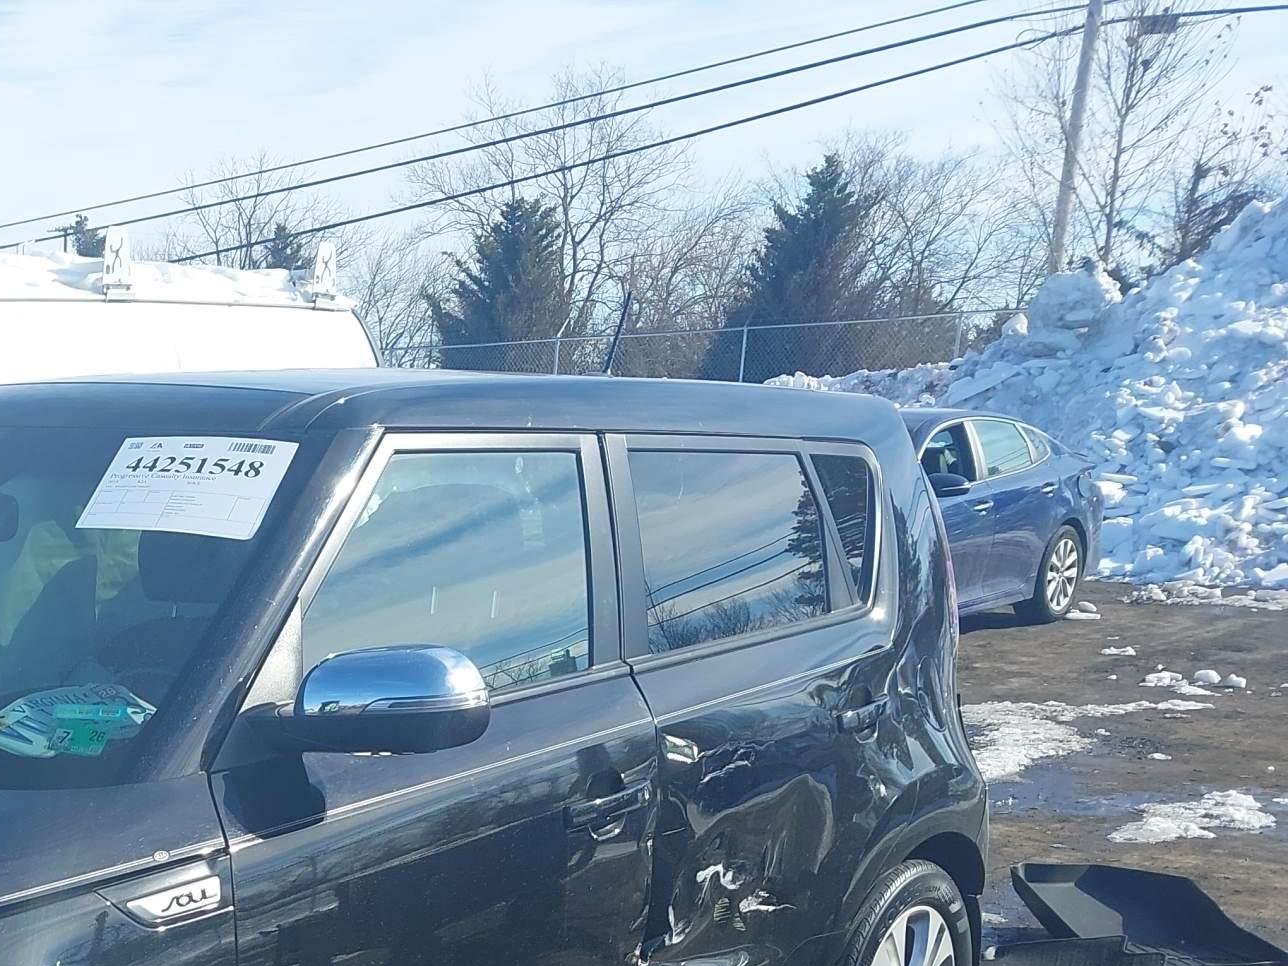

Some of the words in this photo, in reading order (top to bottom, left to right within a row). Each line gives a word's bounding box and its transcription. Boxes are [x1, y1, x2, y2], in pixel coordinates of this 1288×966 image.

[110, 473, 150, 481] Progressive
[150, 473, 182, 481] Casualty
[126, 456, 265, 478] 44251548
[11, 694, 85, 714] VIRGINIA
